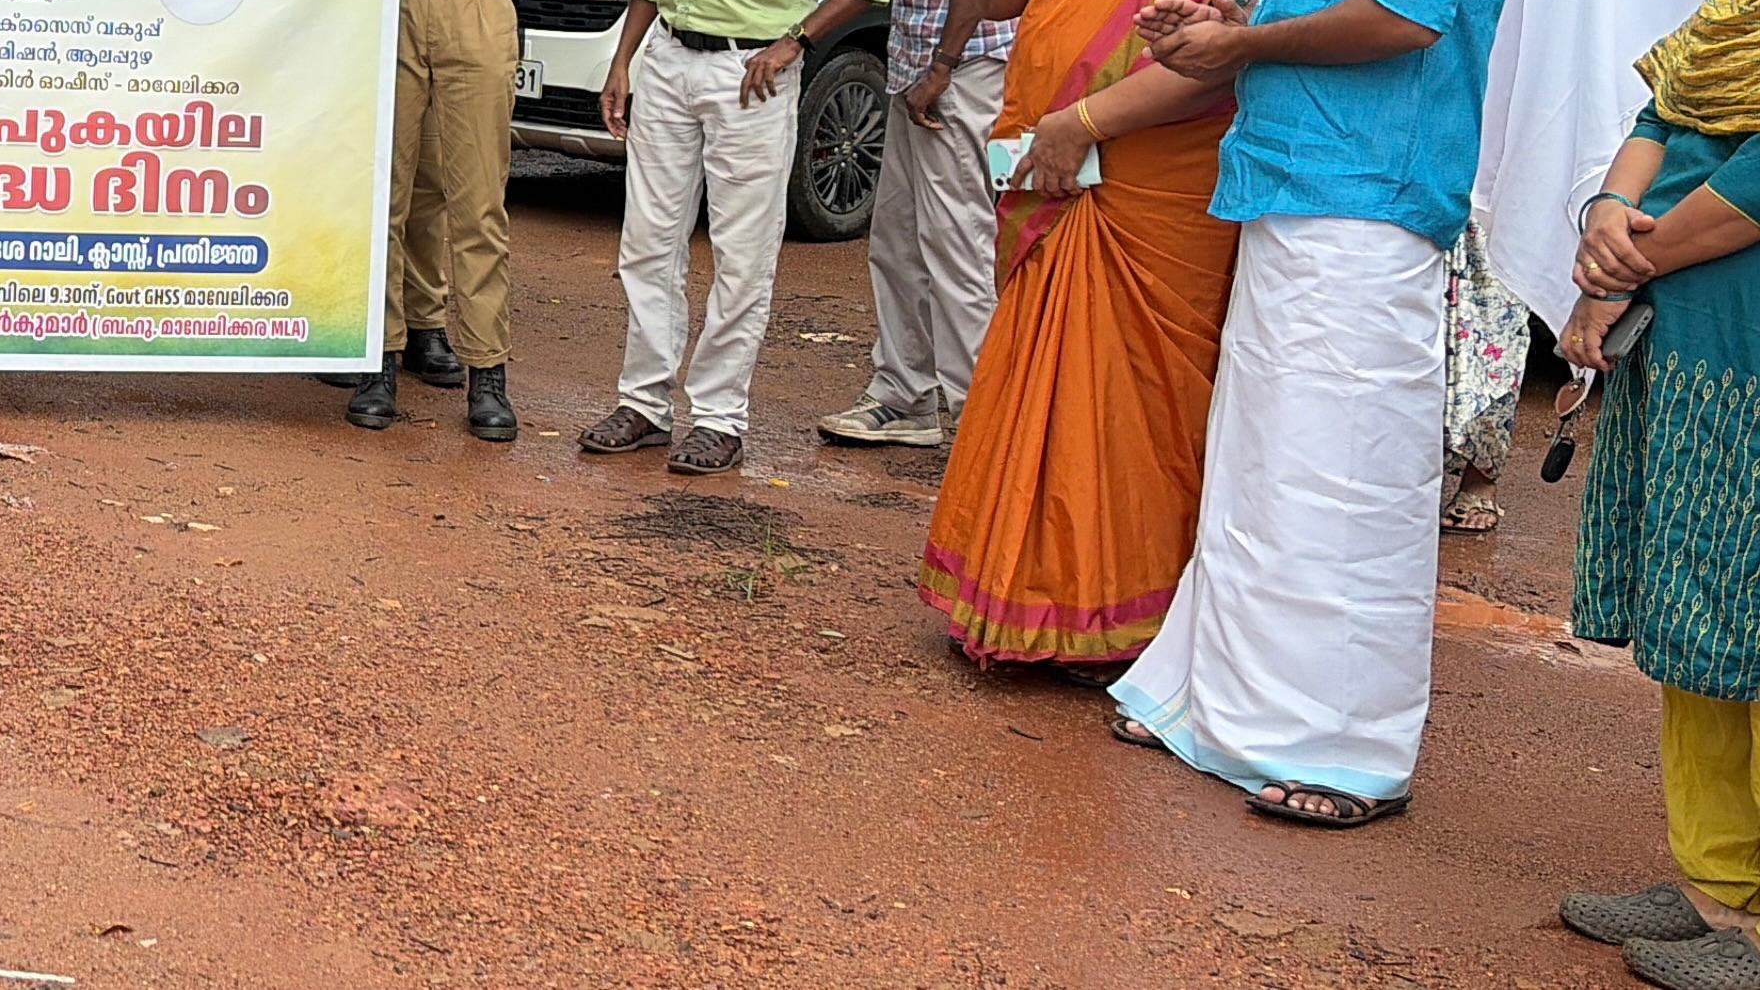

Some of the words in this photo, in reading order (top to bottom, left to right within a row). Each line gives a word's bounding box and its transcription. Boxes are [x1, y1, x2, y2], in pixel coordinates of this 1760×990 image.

[96, 17, 164, 42] വകുപ്പ്
[65, 47, 153, 70] ആലപ്പുഴ
[39, 71, 112, 92] ഓഫീസ്
[127, 74, 240, 96] മാവേലിക്കര
[92, 150, 270, 216] ദിനം
[28, 234, 84, 266] റാലി,
[156, 236, 259, 269] പ്രതിജ്ഞ
[49, 284, 103, 307] 9.30ന്,
[106, 287, 141, 306] Govt
[144, 287, 180, 307] GHSS
[184, 285, 290, 308] മാവേലിക്കര
[160, 314, 268, 338] മാവേലിക്കര
[270, 318, 308, 340] MLA)
